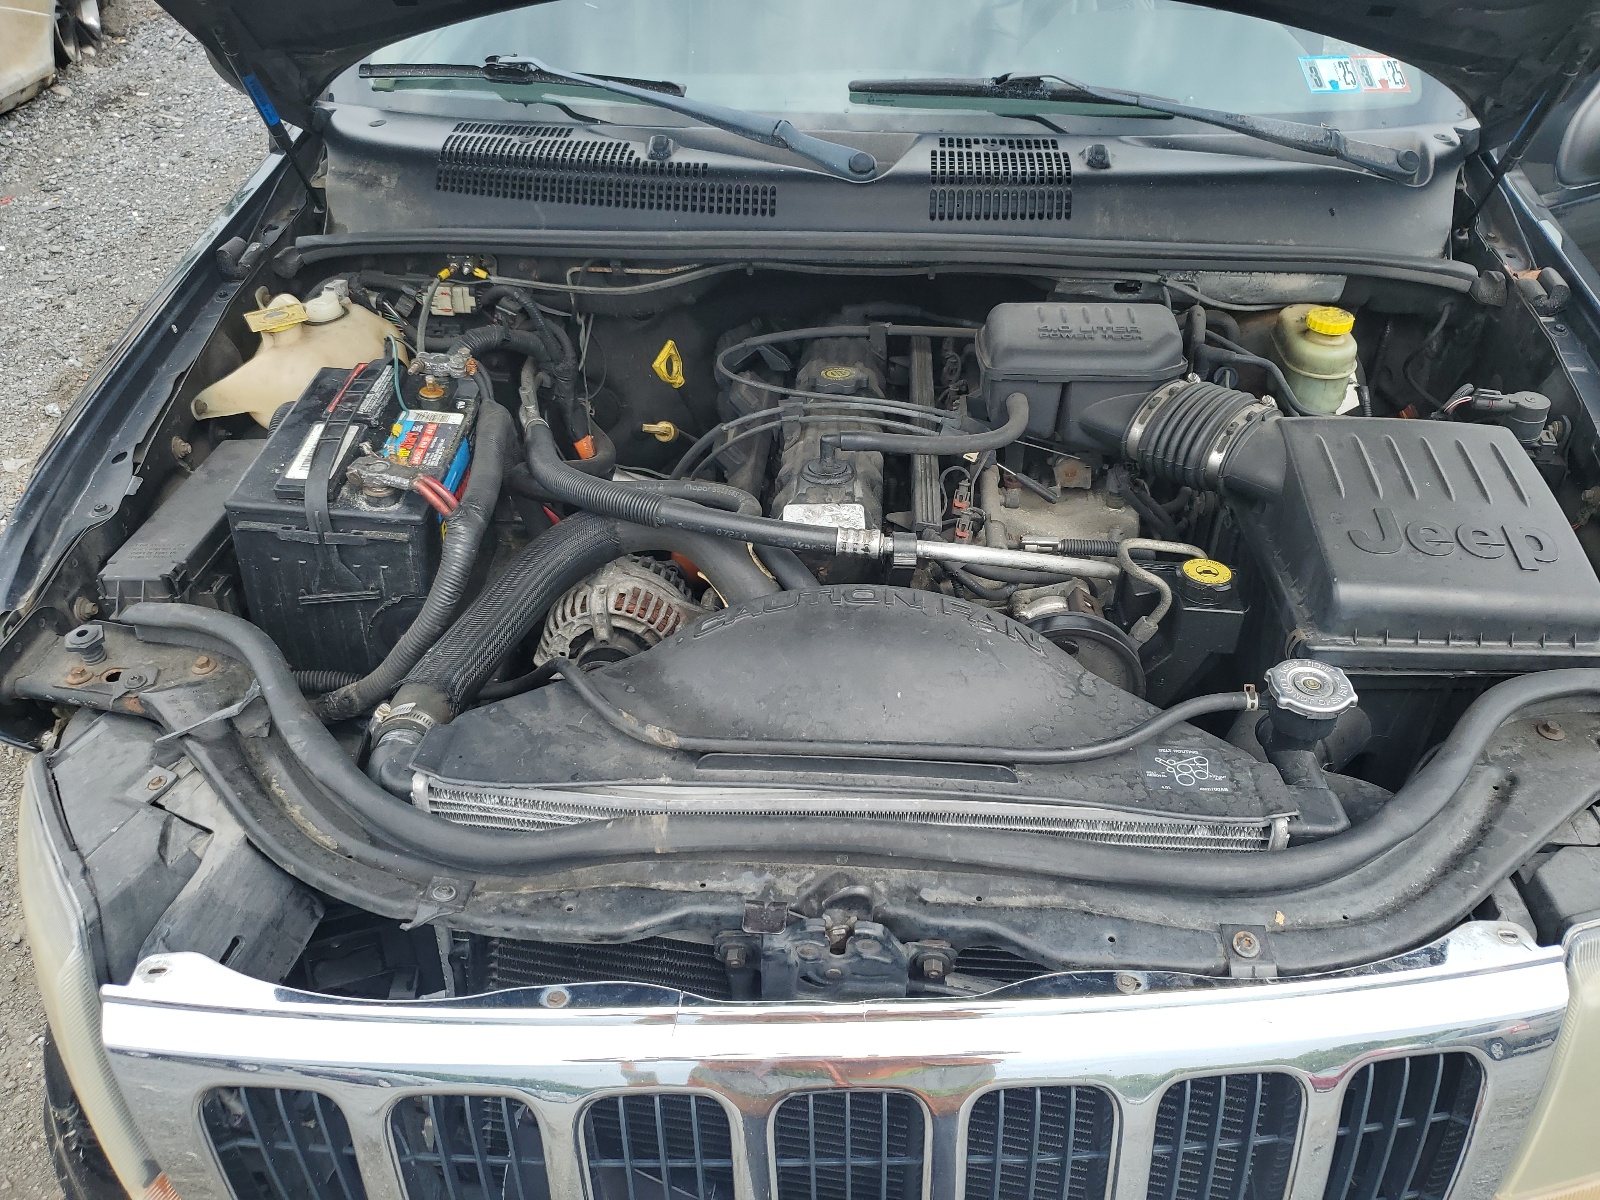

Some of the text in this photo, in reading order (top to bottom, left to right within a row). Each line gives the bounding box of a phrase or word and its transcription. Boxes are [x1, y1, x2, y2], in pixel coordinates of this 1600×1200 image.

[1338, 60, 1356, 86] 25
[1387, 60, 1405, 86] 25
[1347, 507, 1560, 572] Jeep
[693, 587, 1048, 658] CAUTION FAN
[1292, 692, 1316, 705] NOT
